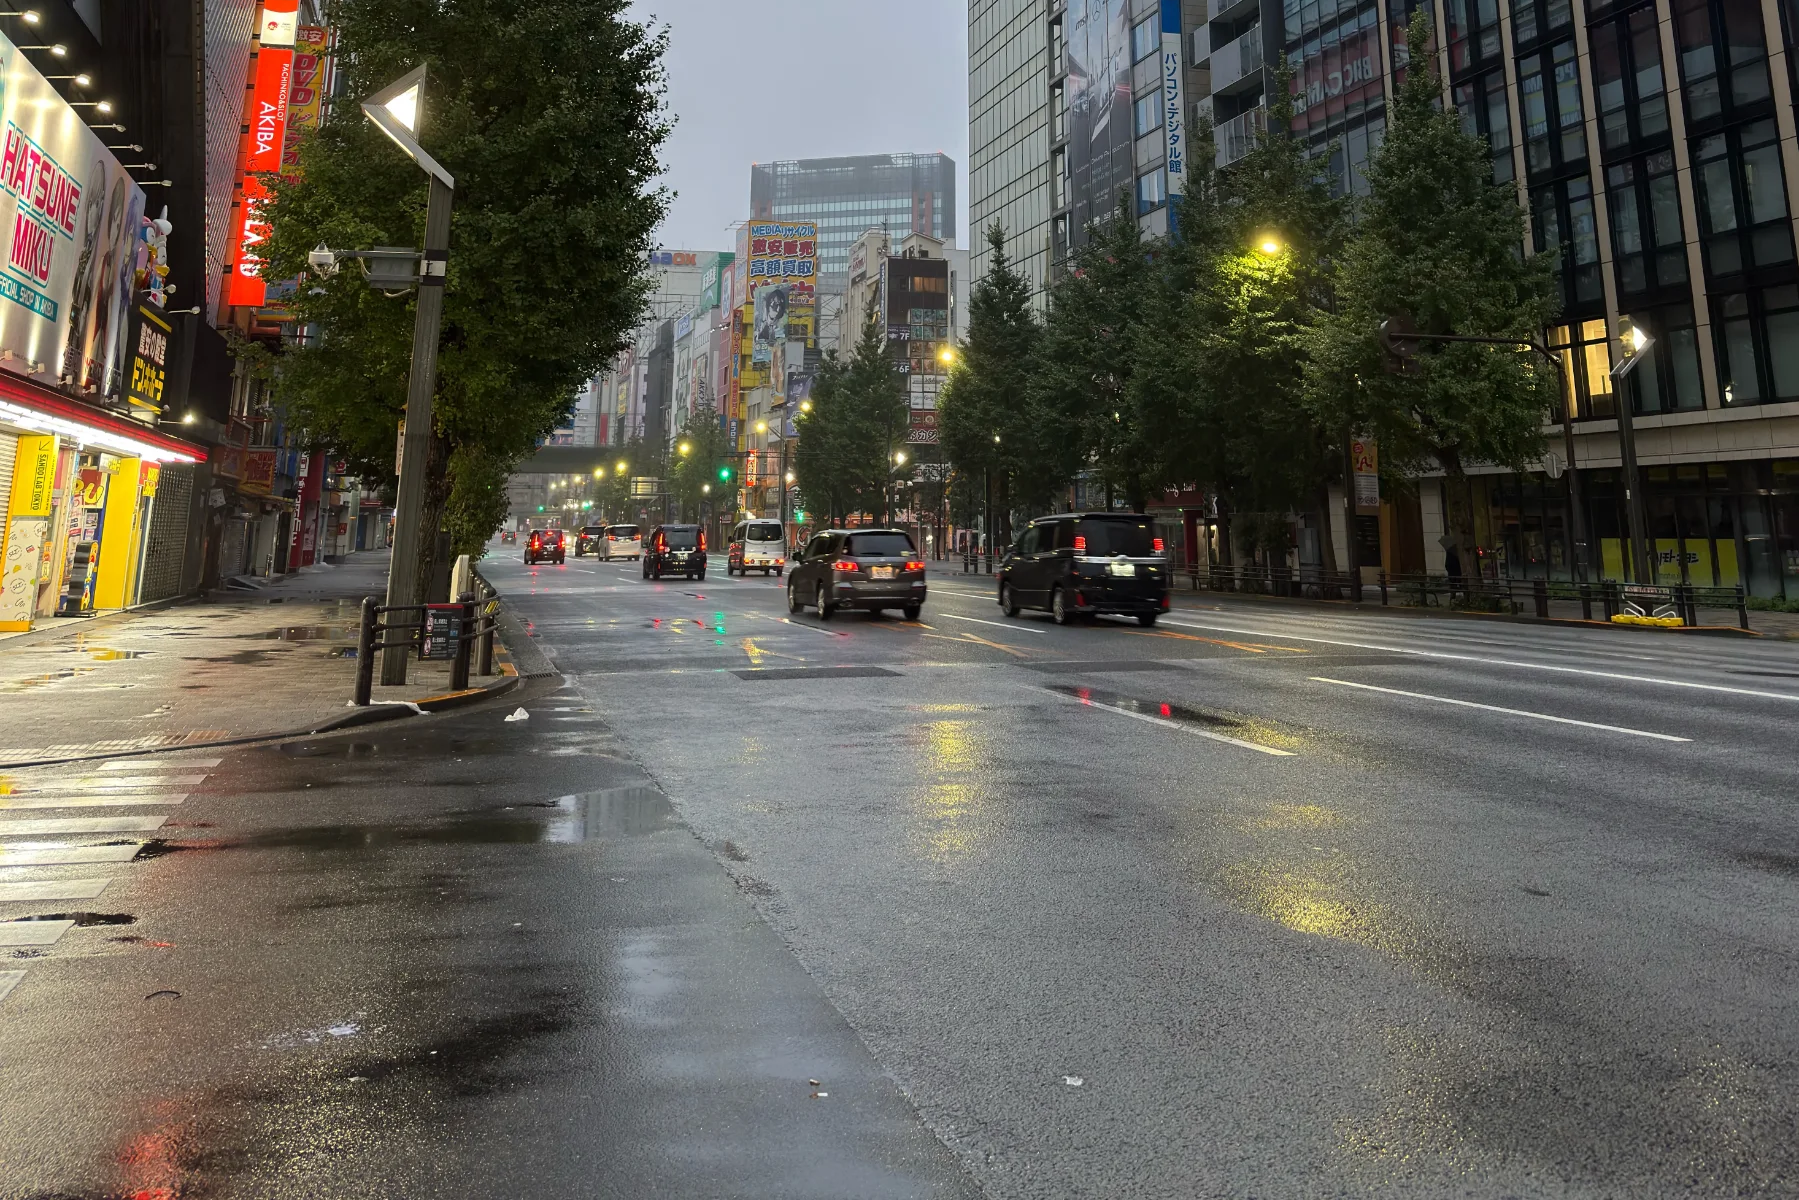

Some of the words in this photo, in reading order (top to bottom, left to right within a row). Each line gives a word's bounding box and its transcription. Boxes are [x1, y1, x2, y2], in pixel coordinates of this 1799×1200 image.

[255, 101, 277, 155] AKIBA
[1164, 52, 1183, 175] パソコン・デジタル館
[0, 129, 81, 234] HATSUNE
[11, 213, 54, 282] MIKU
[33, 491, 41, 511] TOKYO
